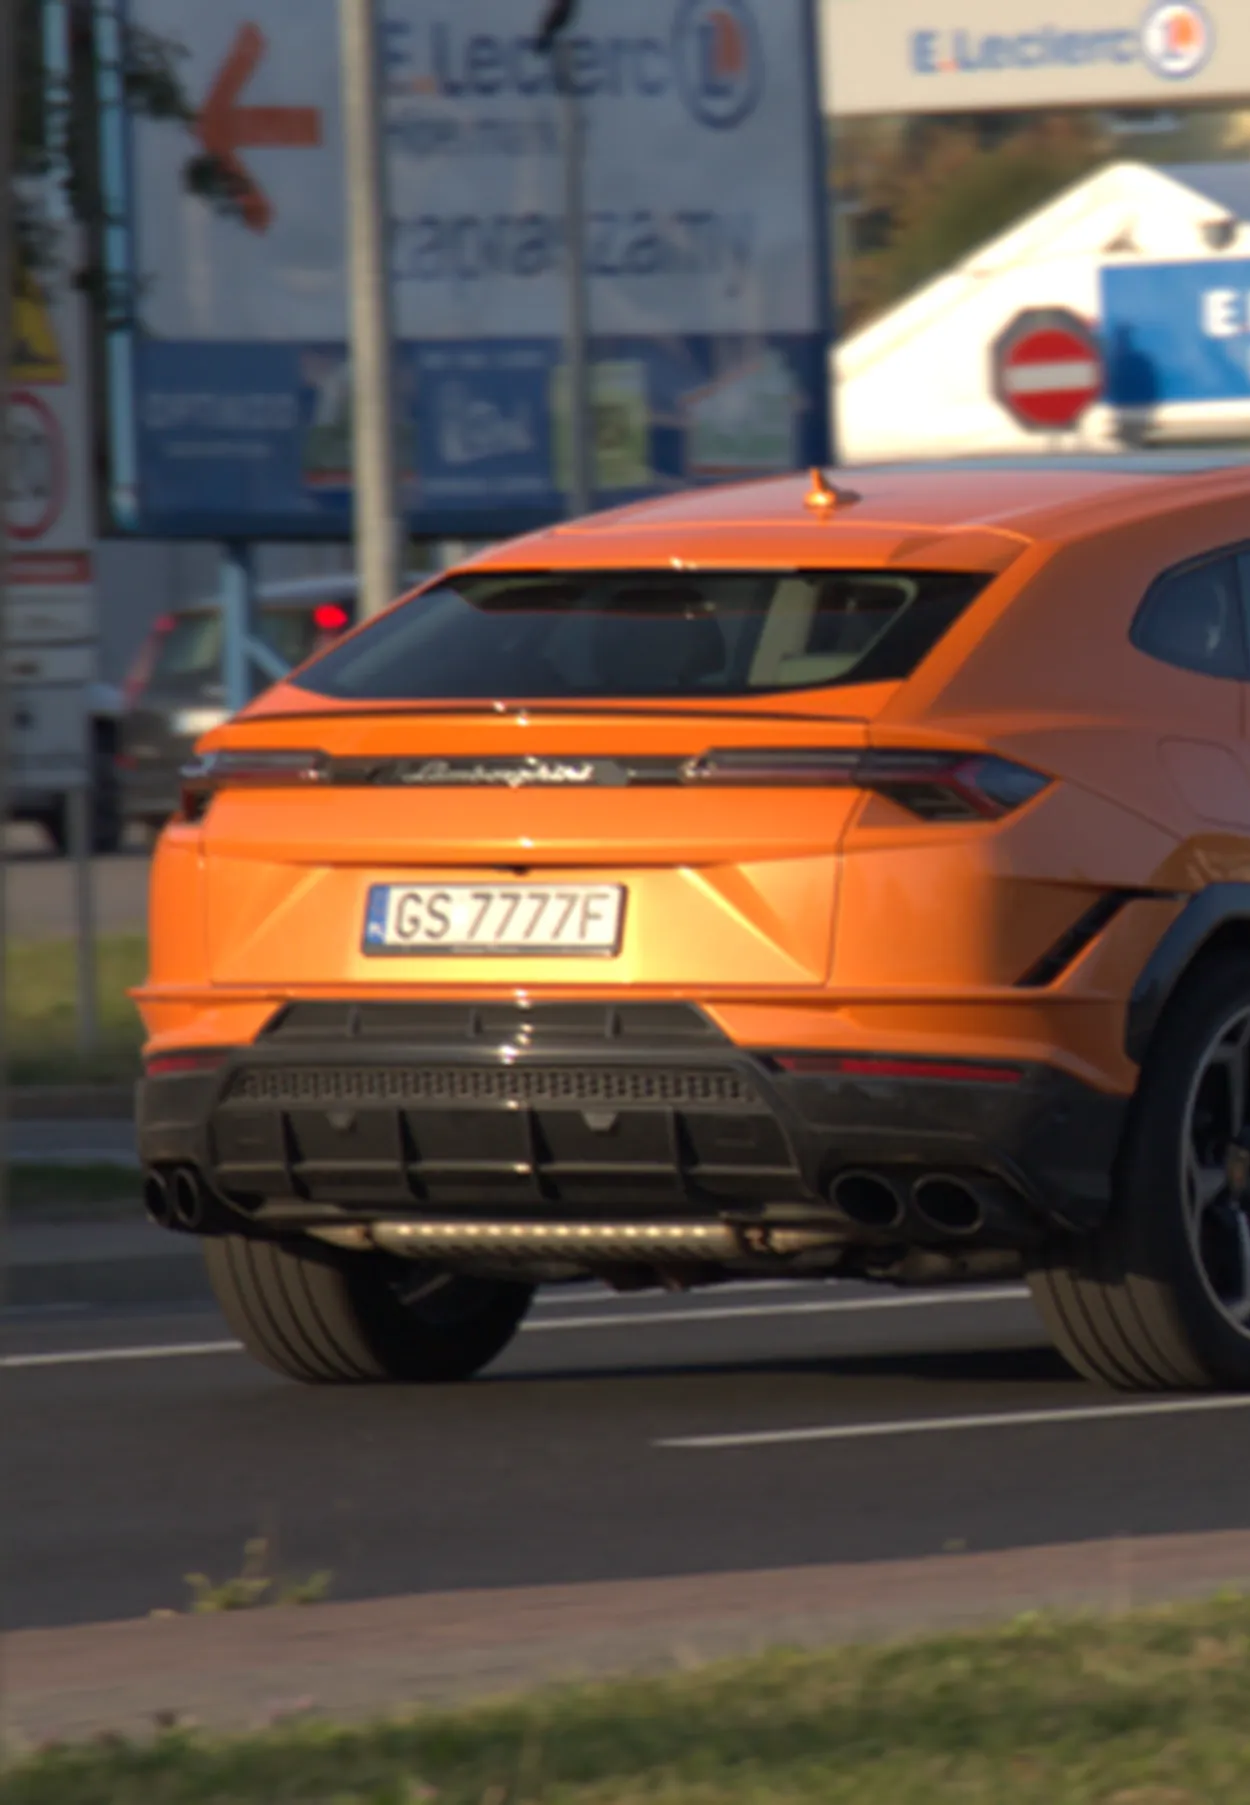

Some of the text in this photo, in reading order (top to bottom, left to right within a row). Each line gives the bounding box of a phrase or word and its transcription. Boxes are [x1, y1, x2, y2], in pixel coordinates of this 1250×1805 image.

[379, 20, 666, 95] E.Lecerc
[394, 891, 452, 940] GS
[466, 891, 610, 940] 7777F
